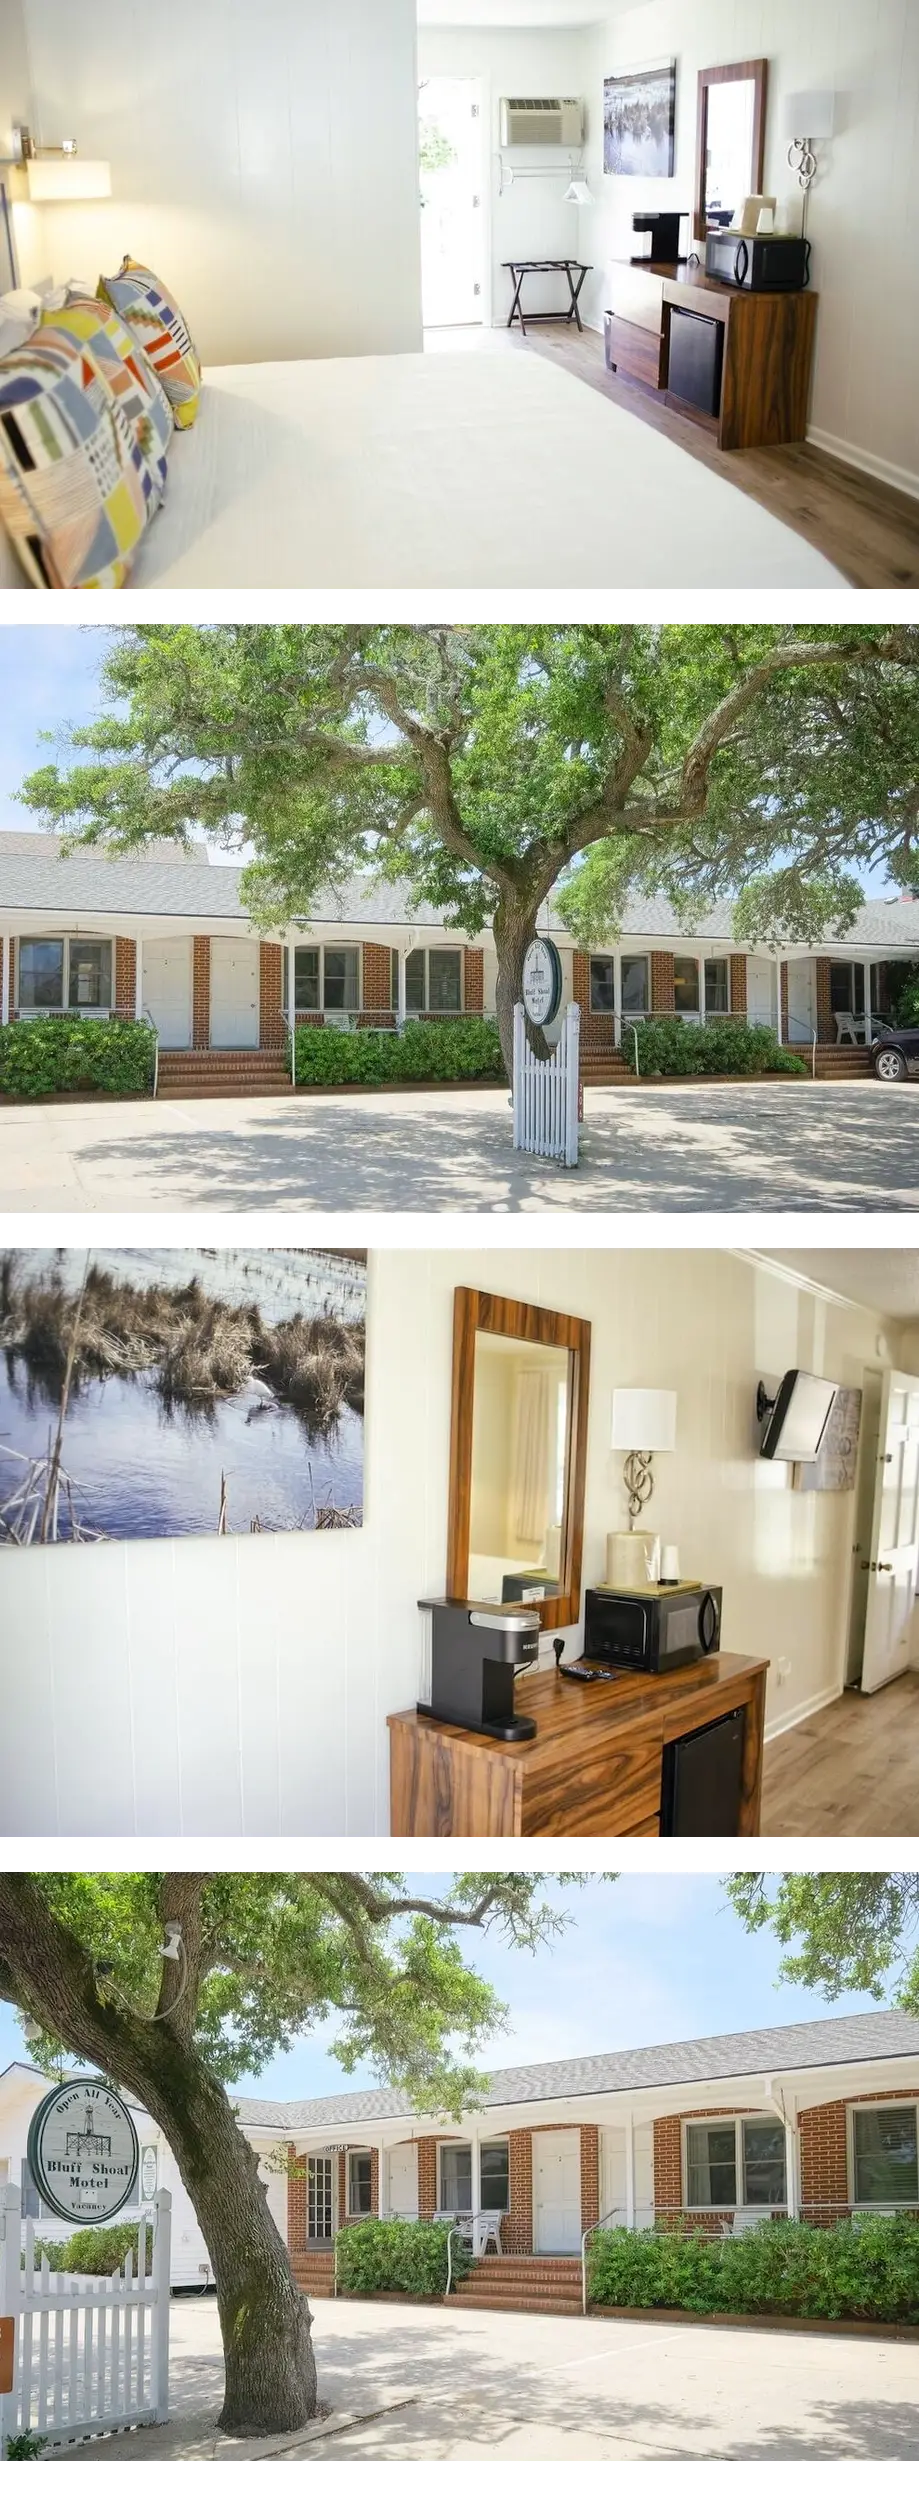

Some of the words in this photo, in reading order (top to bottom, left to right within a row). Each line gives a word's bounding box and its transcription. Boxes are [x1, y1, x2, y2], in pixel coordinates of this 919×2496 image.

[56, 2093, 80, 2114] Open
[84, 2088, 100, 2099] All
[104, 2096, 122, 2120] Year
[47, 2160, 82, 2173] Bluff
[92, 2163, 129, 2175] Shoal
[69, 2176, 109, 2188] Motel
[71, 2202, 107, 2211] Vacancy
